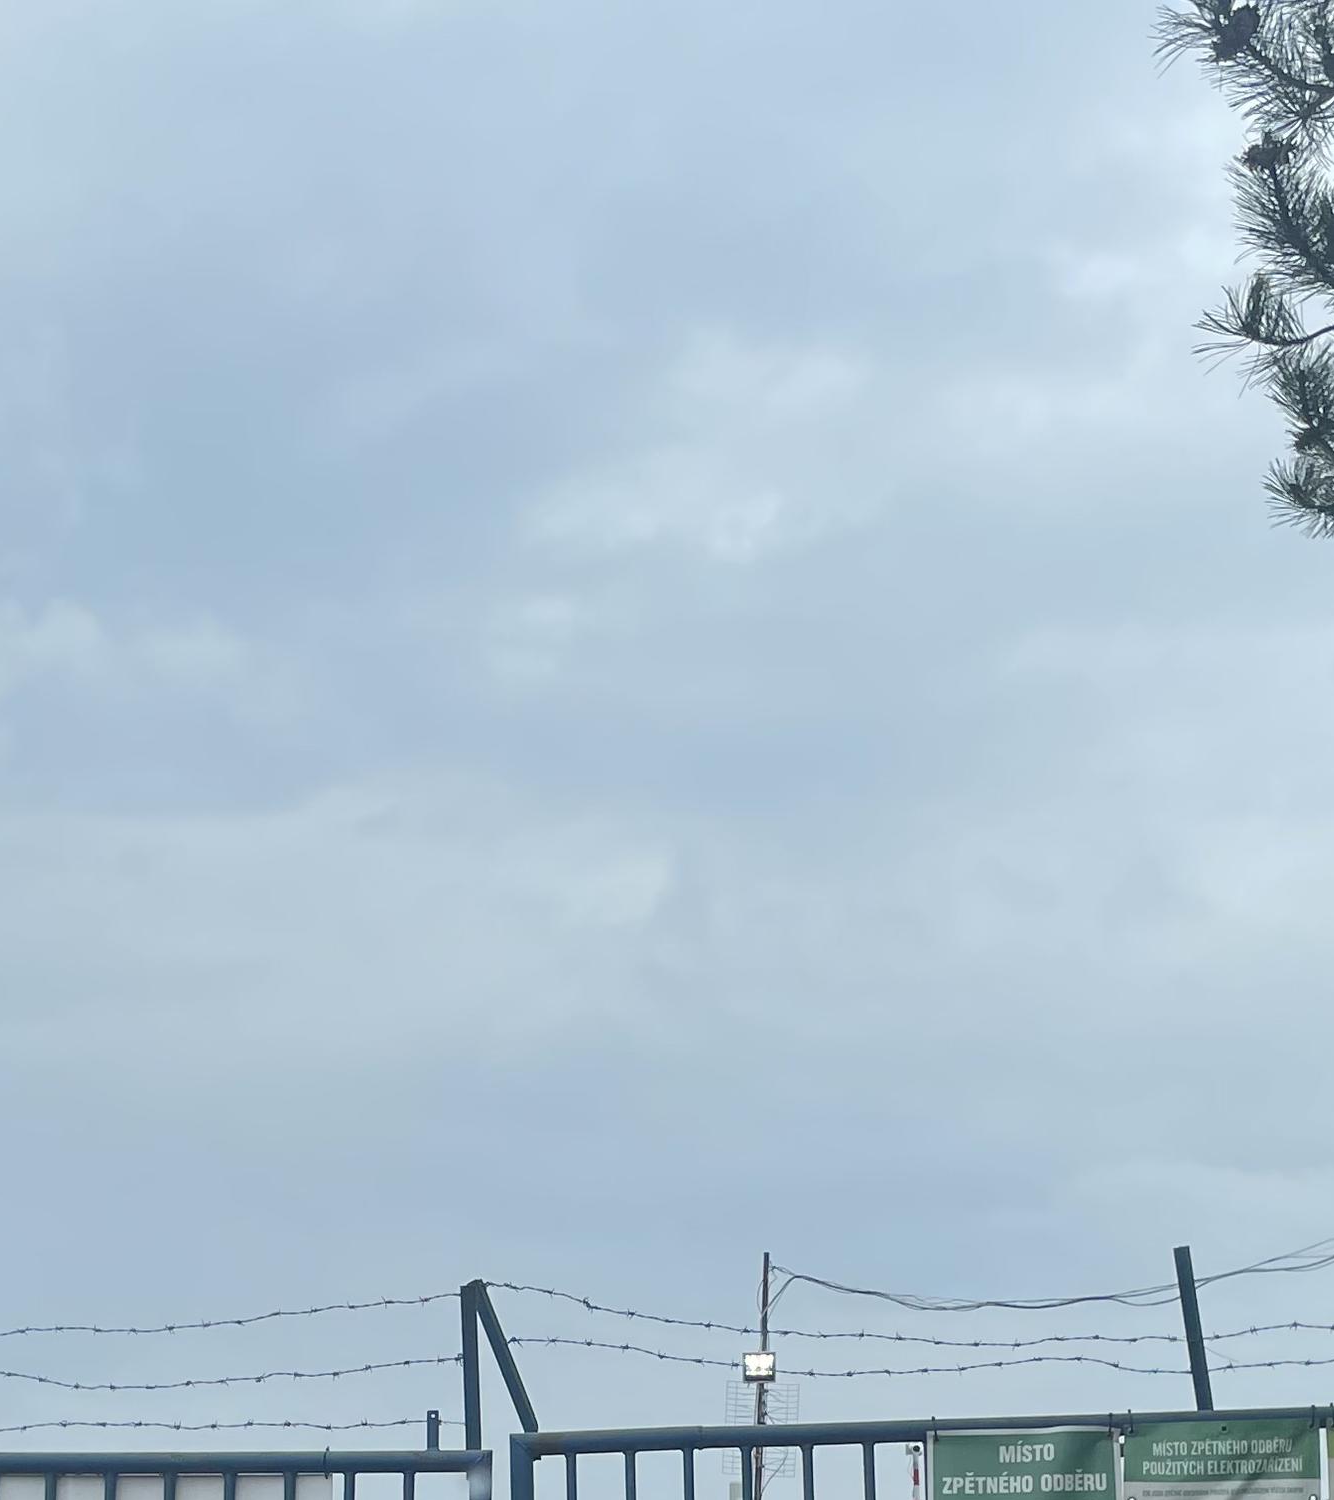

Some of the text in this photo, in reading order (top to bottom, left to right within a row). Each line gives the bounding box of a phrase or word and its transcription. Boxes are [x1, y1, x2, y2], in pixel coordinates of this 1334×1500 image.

[999, 1440, 1055, 1463] MÍSTO
[1152, 1436, 1293, 1457] MÍSTO ZPĚTNÉHO ODBĚRU
[1142, 1456, 1303, 1475] POUŽITÝCH ELEKTROZAŘÍZENÍ
[942, 1469, 1107, 1495] ZPĚTNÉHO ODBĚRU
